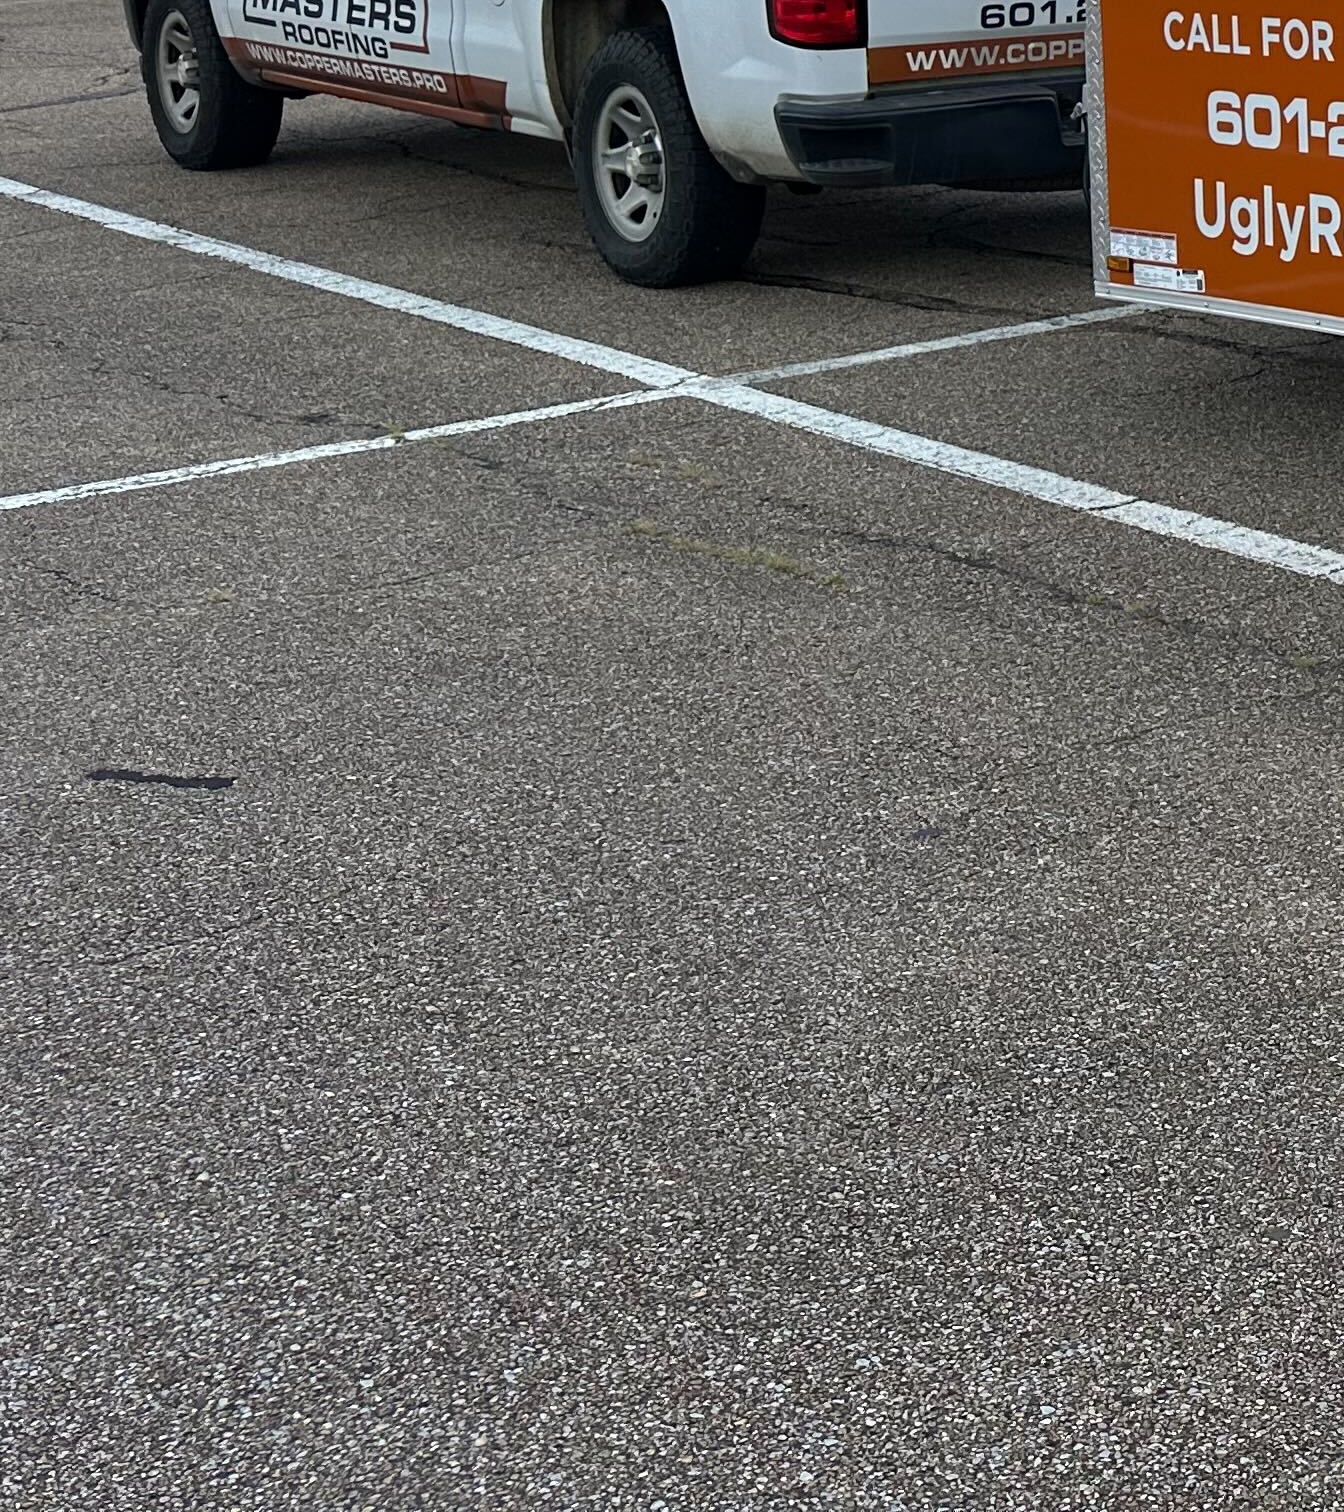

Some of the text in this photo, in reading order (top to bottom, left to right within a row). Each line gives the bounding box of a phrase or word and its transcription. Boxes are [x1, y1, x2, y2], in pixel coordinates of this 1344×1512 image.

[281, 21, 389, 59] ROOFING
[1163, 10, 1251, 56] CALL
[1262, 17, 1335, 62] FOR
[247, 43, 447, 93] WWW.COPPERMASTERS.PRO
